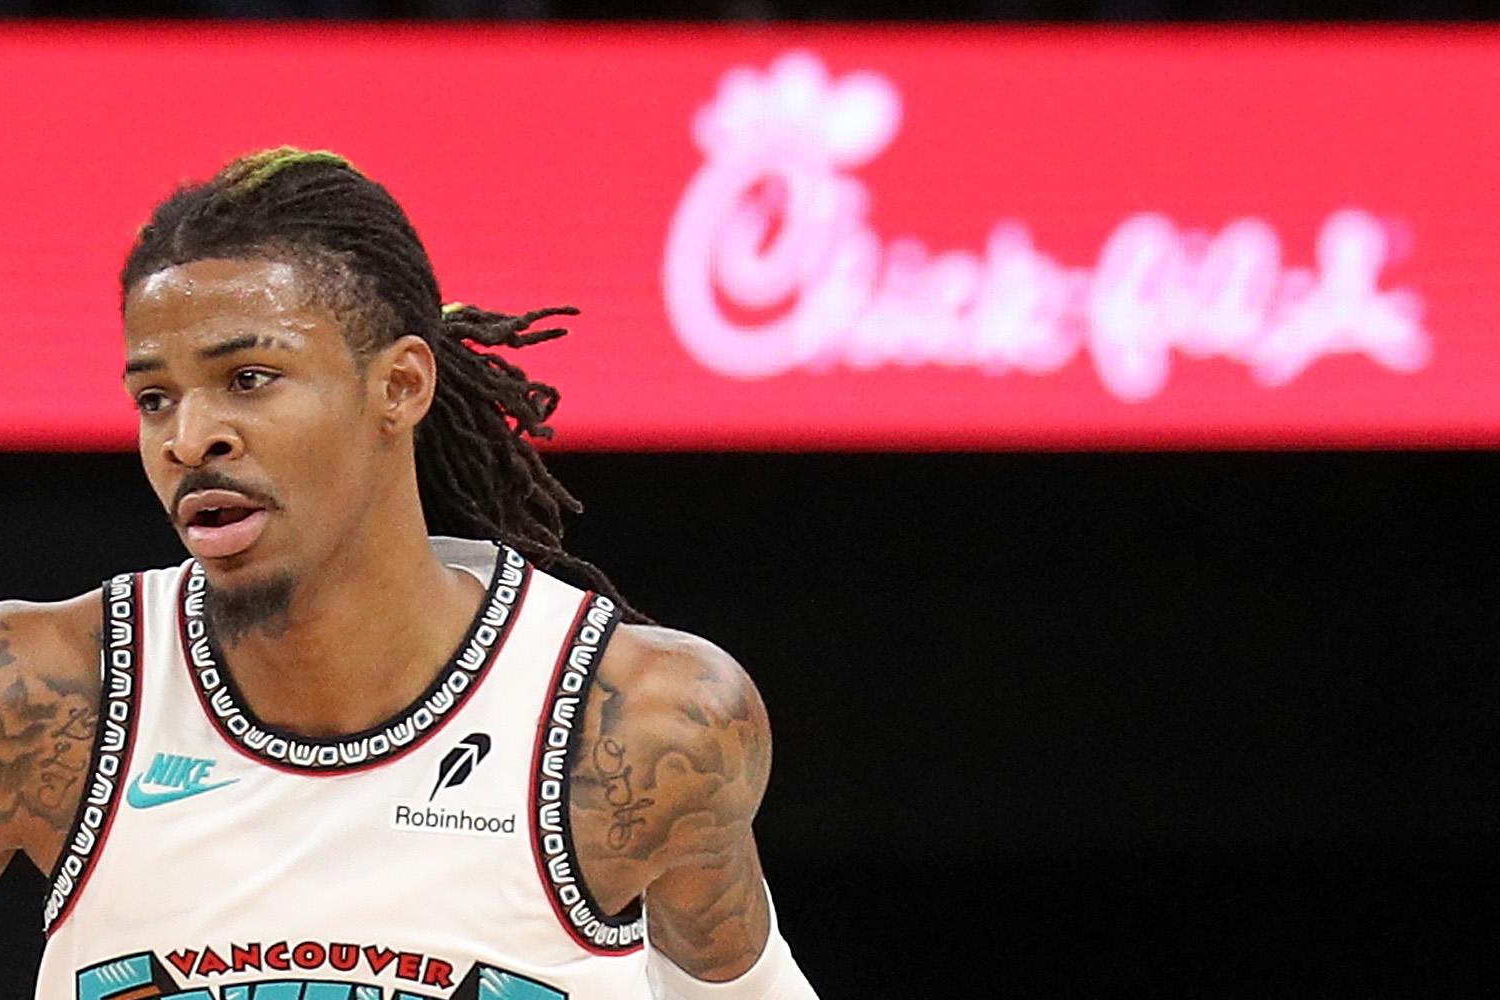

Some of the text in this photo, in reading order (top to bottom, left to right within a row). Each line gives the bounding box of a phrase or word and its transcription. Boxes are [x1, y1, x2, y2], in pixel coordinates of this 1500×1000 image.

[143, 752, 217, 790] NIKE
[395, 805, 516, 833] Robinhood
[165, 941, 455, 988] VANCOUVER
